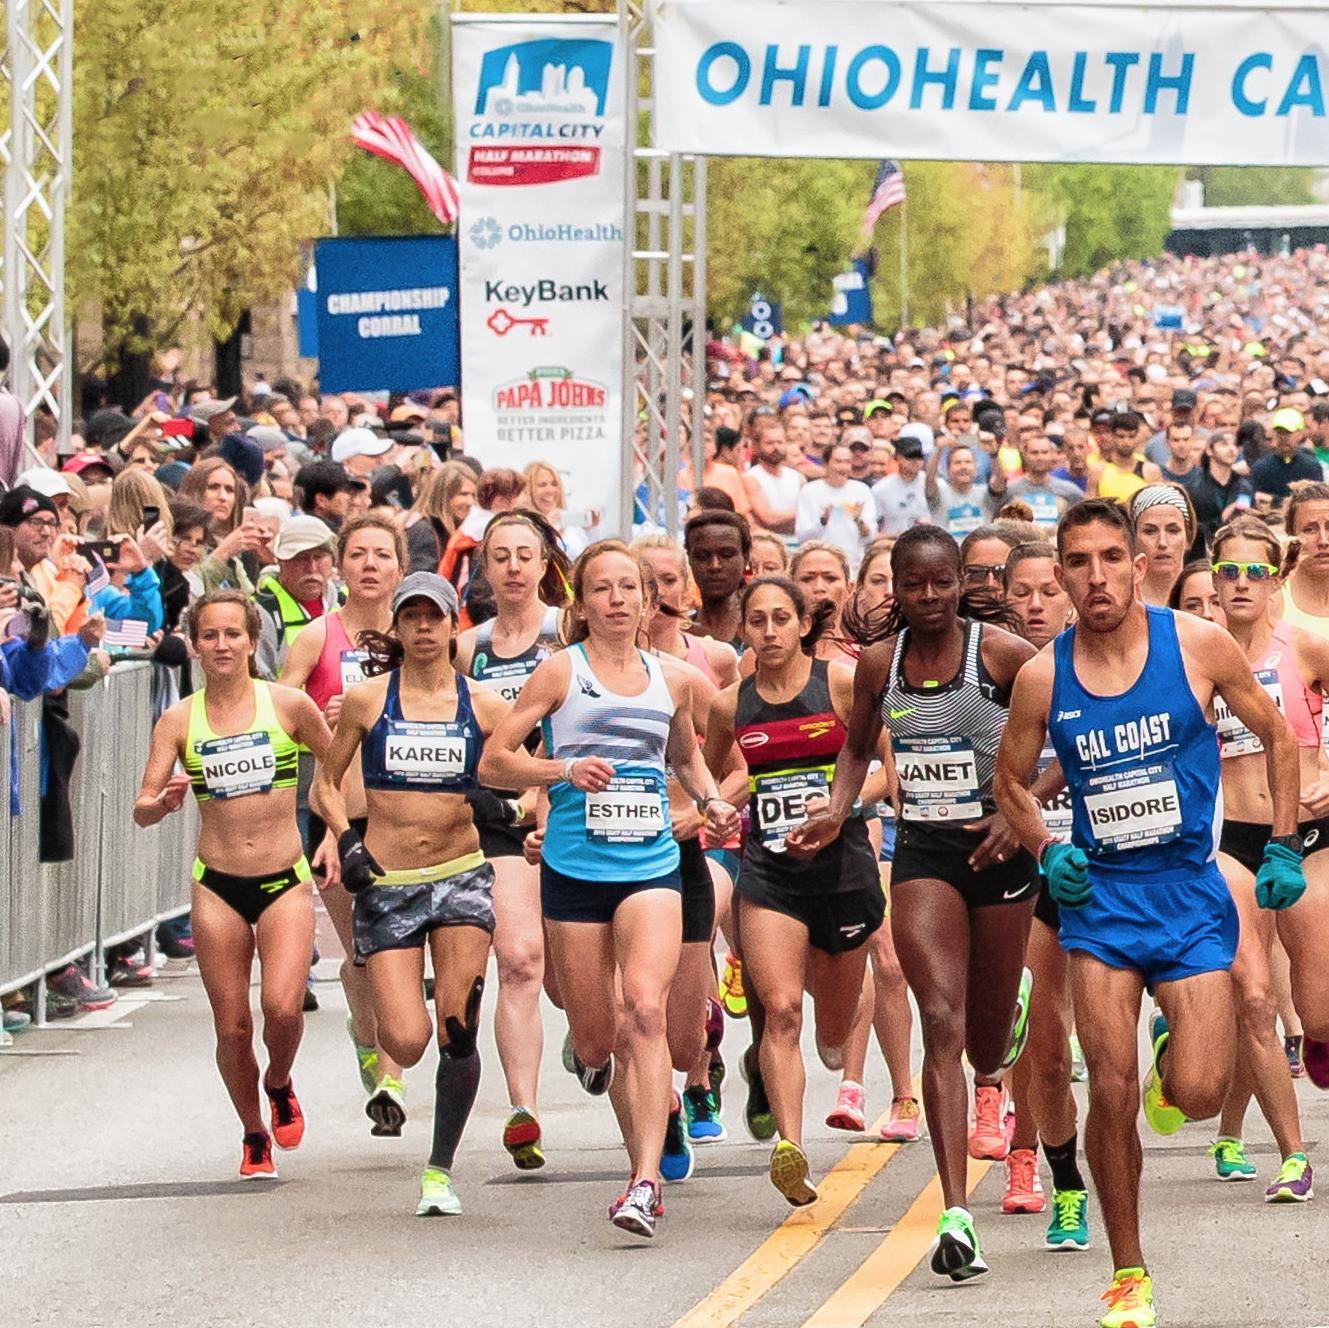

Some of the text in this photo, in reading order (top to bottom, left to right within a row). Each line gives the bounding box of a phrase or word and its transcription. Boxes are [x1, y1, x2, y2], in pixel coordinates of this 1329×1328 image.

[696, 41, 1195, 115] OHIOHEALTH
[508, 224, 624, 241] OhioHealth
[327, 286, 450, 315] CHAMPIONSHIP
[484, 280, 609, 306] KeyBank
[497, 381, 542, 409] PAPA
[497, 427, 555, 442] BETTER
[1076, 712, 1170, 771] CAL COAST
[389, 746, 463, 762] KAREN
[205, 755, 274, 778] NICOLE
[899, 762, 972, 781] JANET
[1148, 765, 1162, 774] CITY
[589, 804, 660, 818] ESTHER
[1091, 795, 1176, 825] ISIDORE
